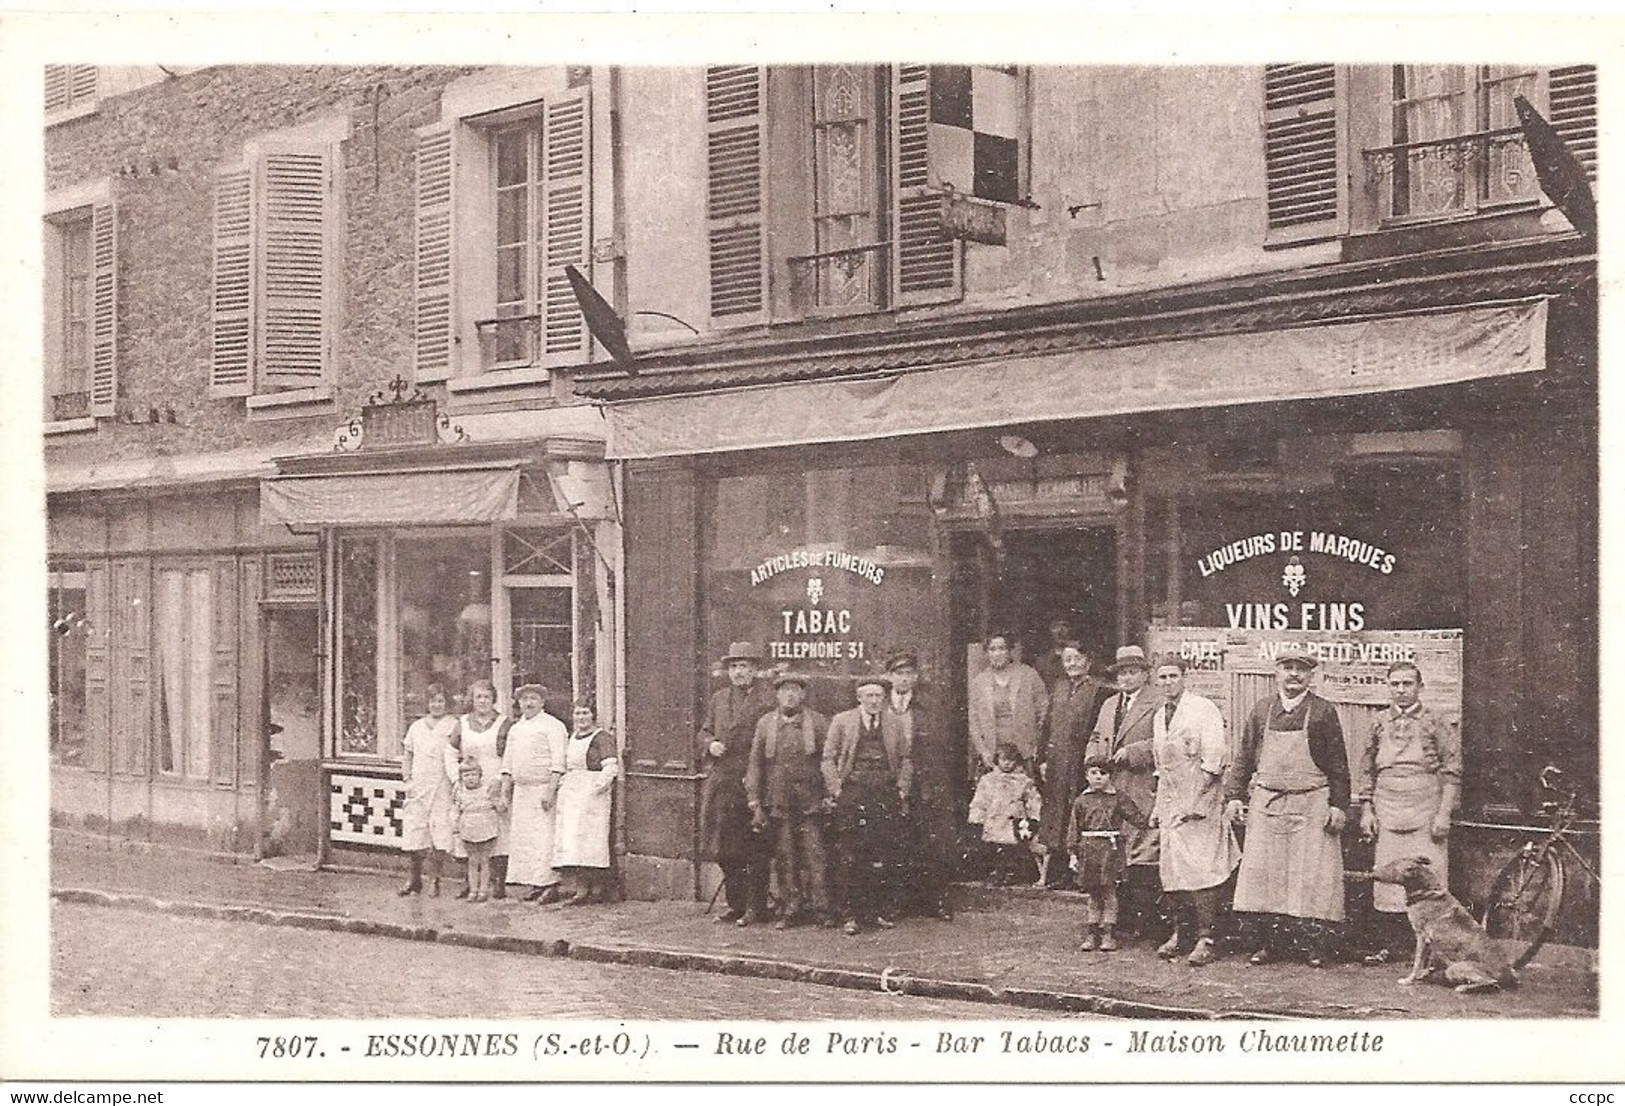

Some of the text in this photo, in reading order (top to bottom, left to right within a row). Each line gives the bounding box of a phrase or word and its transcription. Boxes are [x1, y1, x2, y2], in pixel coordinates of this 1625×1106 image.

[750, 550, 885, 586] ARTICLES DE FUMEURS
[1197, 531, 1396, 577] LIQUEURS DE MARQUES
[782, 609, 851, 634] TABAC
[1225, 602, 1365, 631] VINS FINS
[769, 641, 864, 659] TELEPHONE 31
